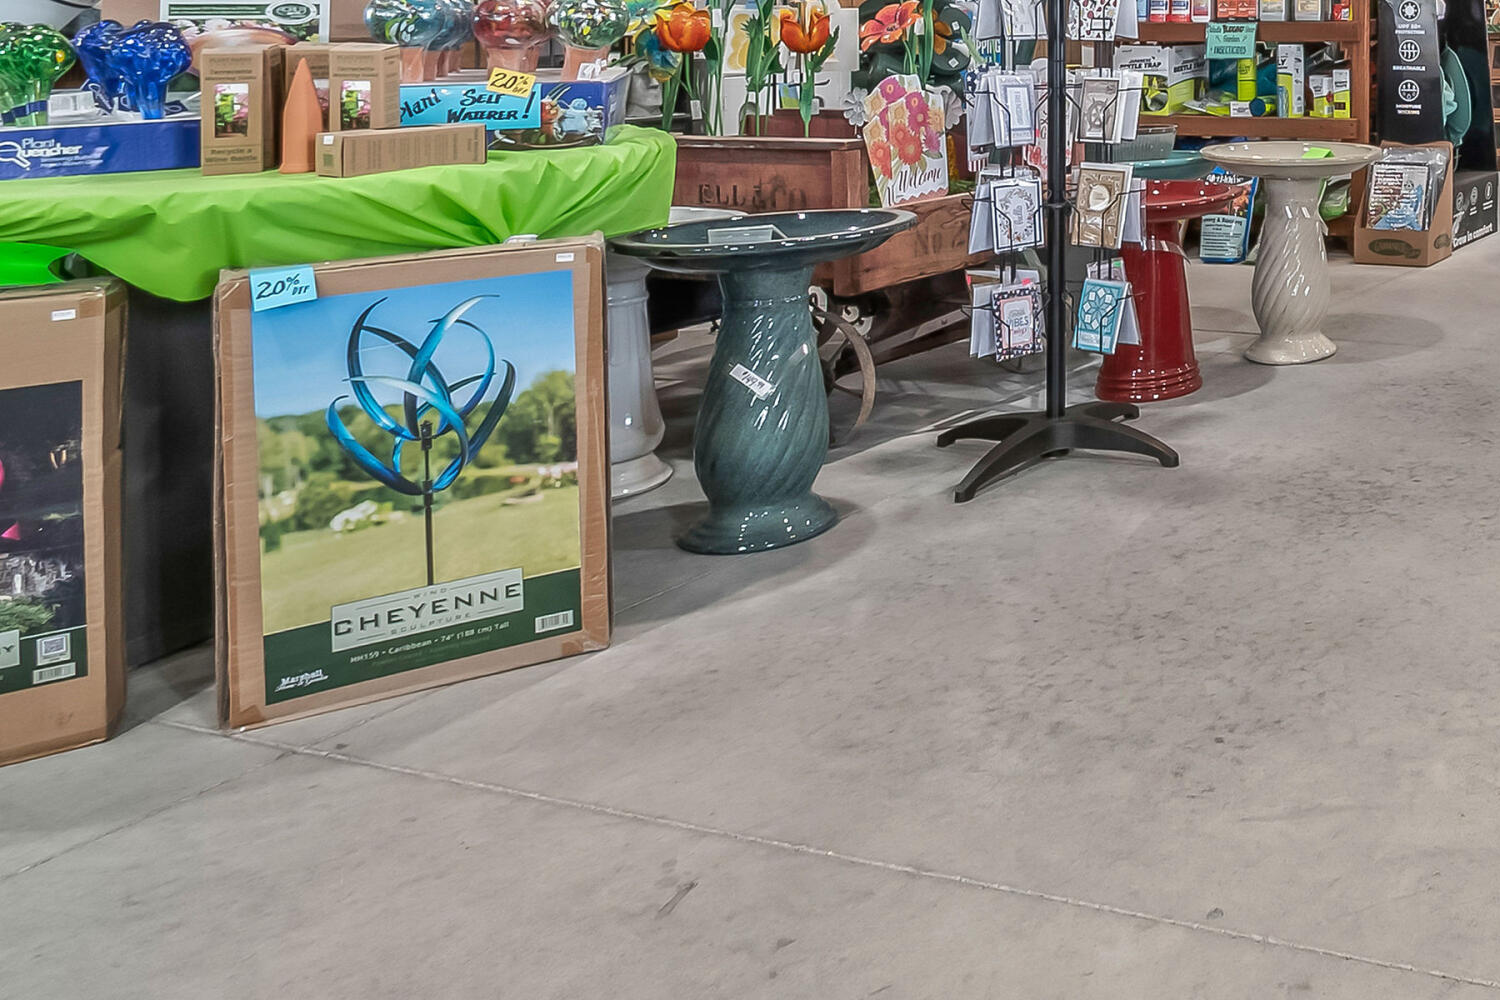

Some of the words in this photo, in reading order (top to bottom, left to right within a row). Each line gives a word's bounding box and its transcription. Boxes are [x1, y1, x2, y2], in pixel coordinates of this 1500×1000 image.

[490, 72, 528, 90] 20%
[22, 137, 55, 149] Plant
[255, 273, 300, 300] 20%
[291, 284, 310, 296] OFF
[412, 587, 448, 599] WIND
[334, 582, 522, 637] CHEYENNE
[390, 612, 472, 636] SCULPTURE
[388, 639, 432, 655] Caribbean
